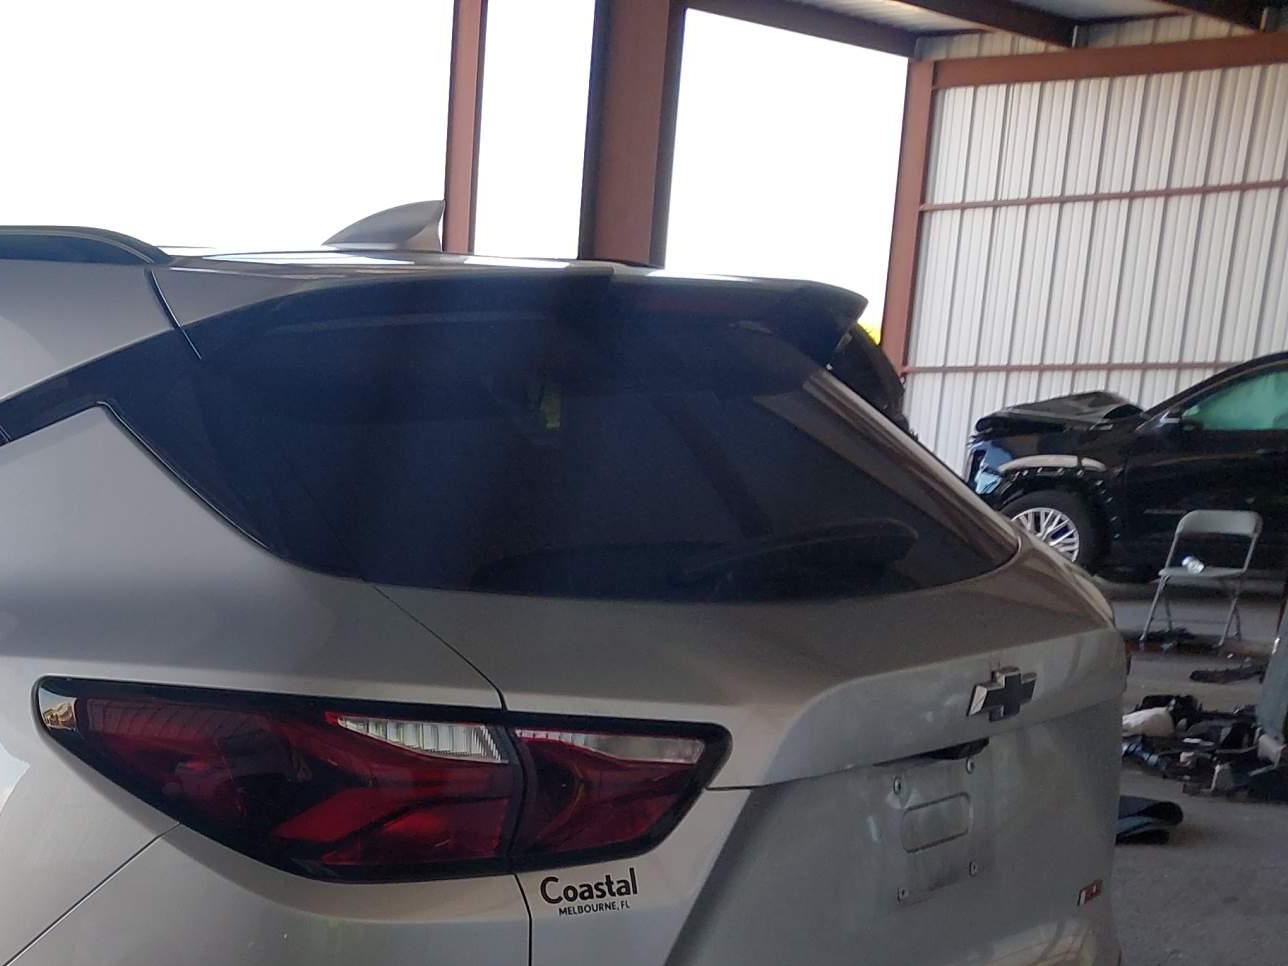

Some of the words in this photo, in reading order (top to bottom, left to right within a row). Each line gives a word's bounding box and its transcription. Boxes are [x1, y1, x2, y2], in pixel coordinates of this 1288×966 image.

[540, 867, 638, 904] Coastal
[558, 901, 620, 916] MELBOURNE,
[621, 900, 631, 910] FL
